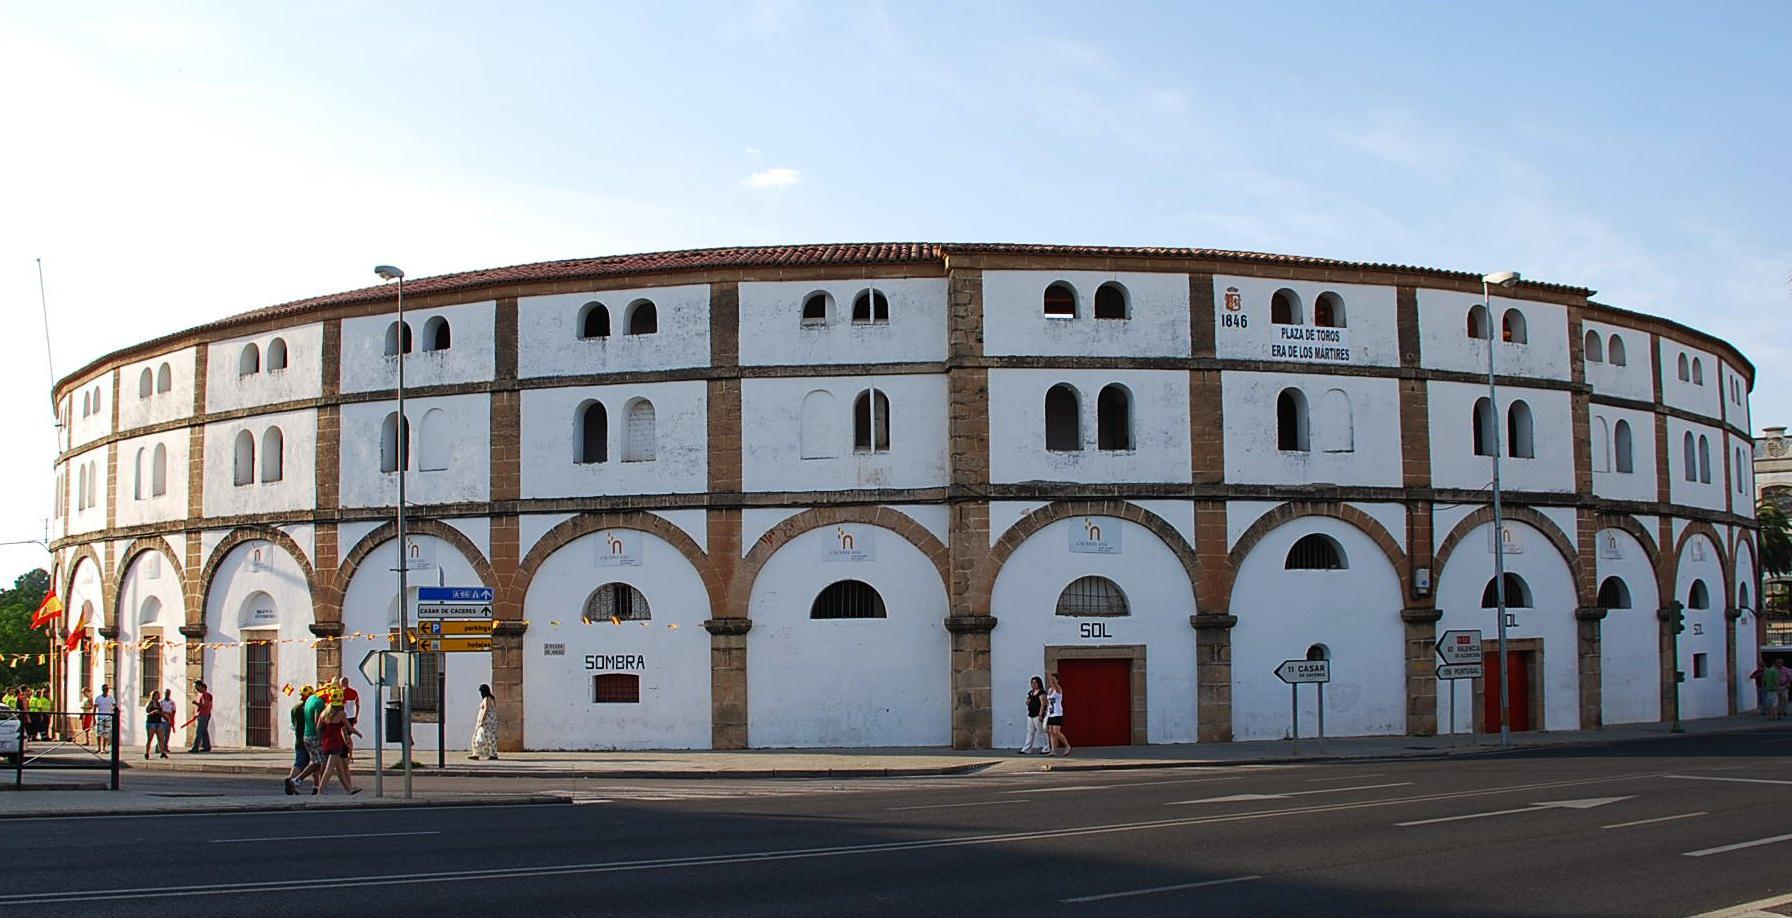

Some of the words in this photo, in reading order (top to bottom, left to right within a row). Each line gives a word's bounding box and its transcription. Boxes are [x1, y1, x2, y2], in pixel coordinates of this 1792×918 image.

[1221, 314, 1248, 328] 1846
[1281, 328, 1304, 340] PLAZA
[1306, 329, 1315, 341] DE
[1316, 330, 1340, 342] TOROS
[1272, 345, 1287, 357] ERA
[1288, 346, 1298, 358] DE
[1299, 347, 1313, 358] LOS
[1505, 614, 1519, 627] OL
[1081, 623, 1112, 637] SOL
[585, 655, 645, 670] SOMBRA
